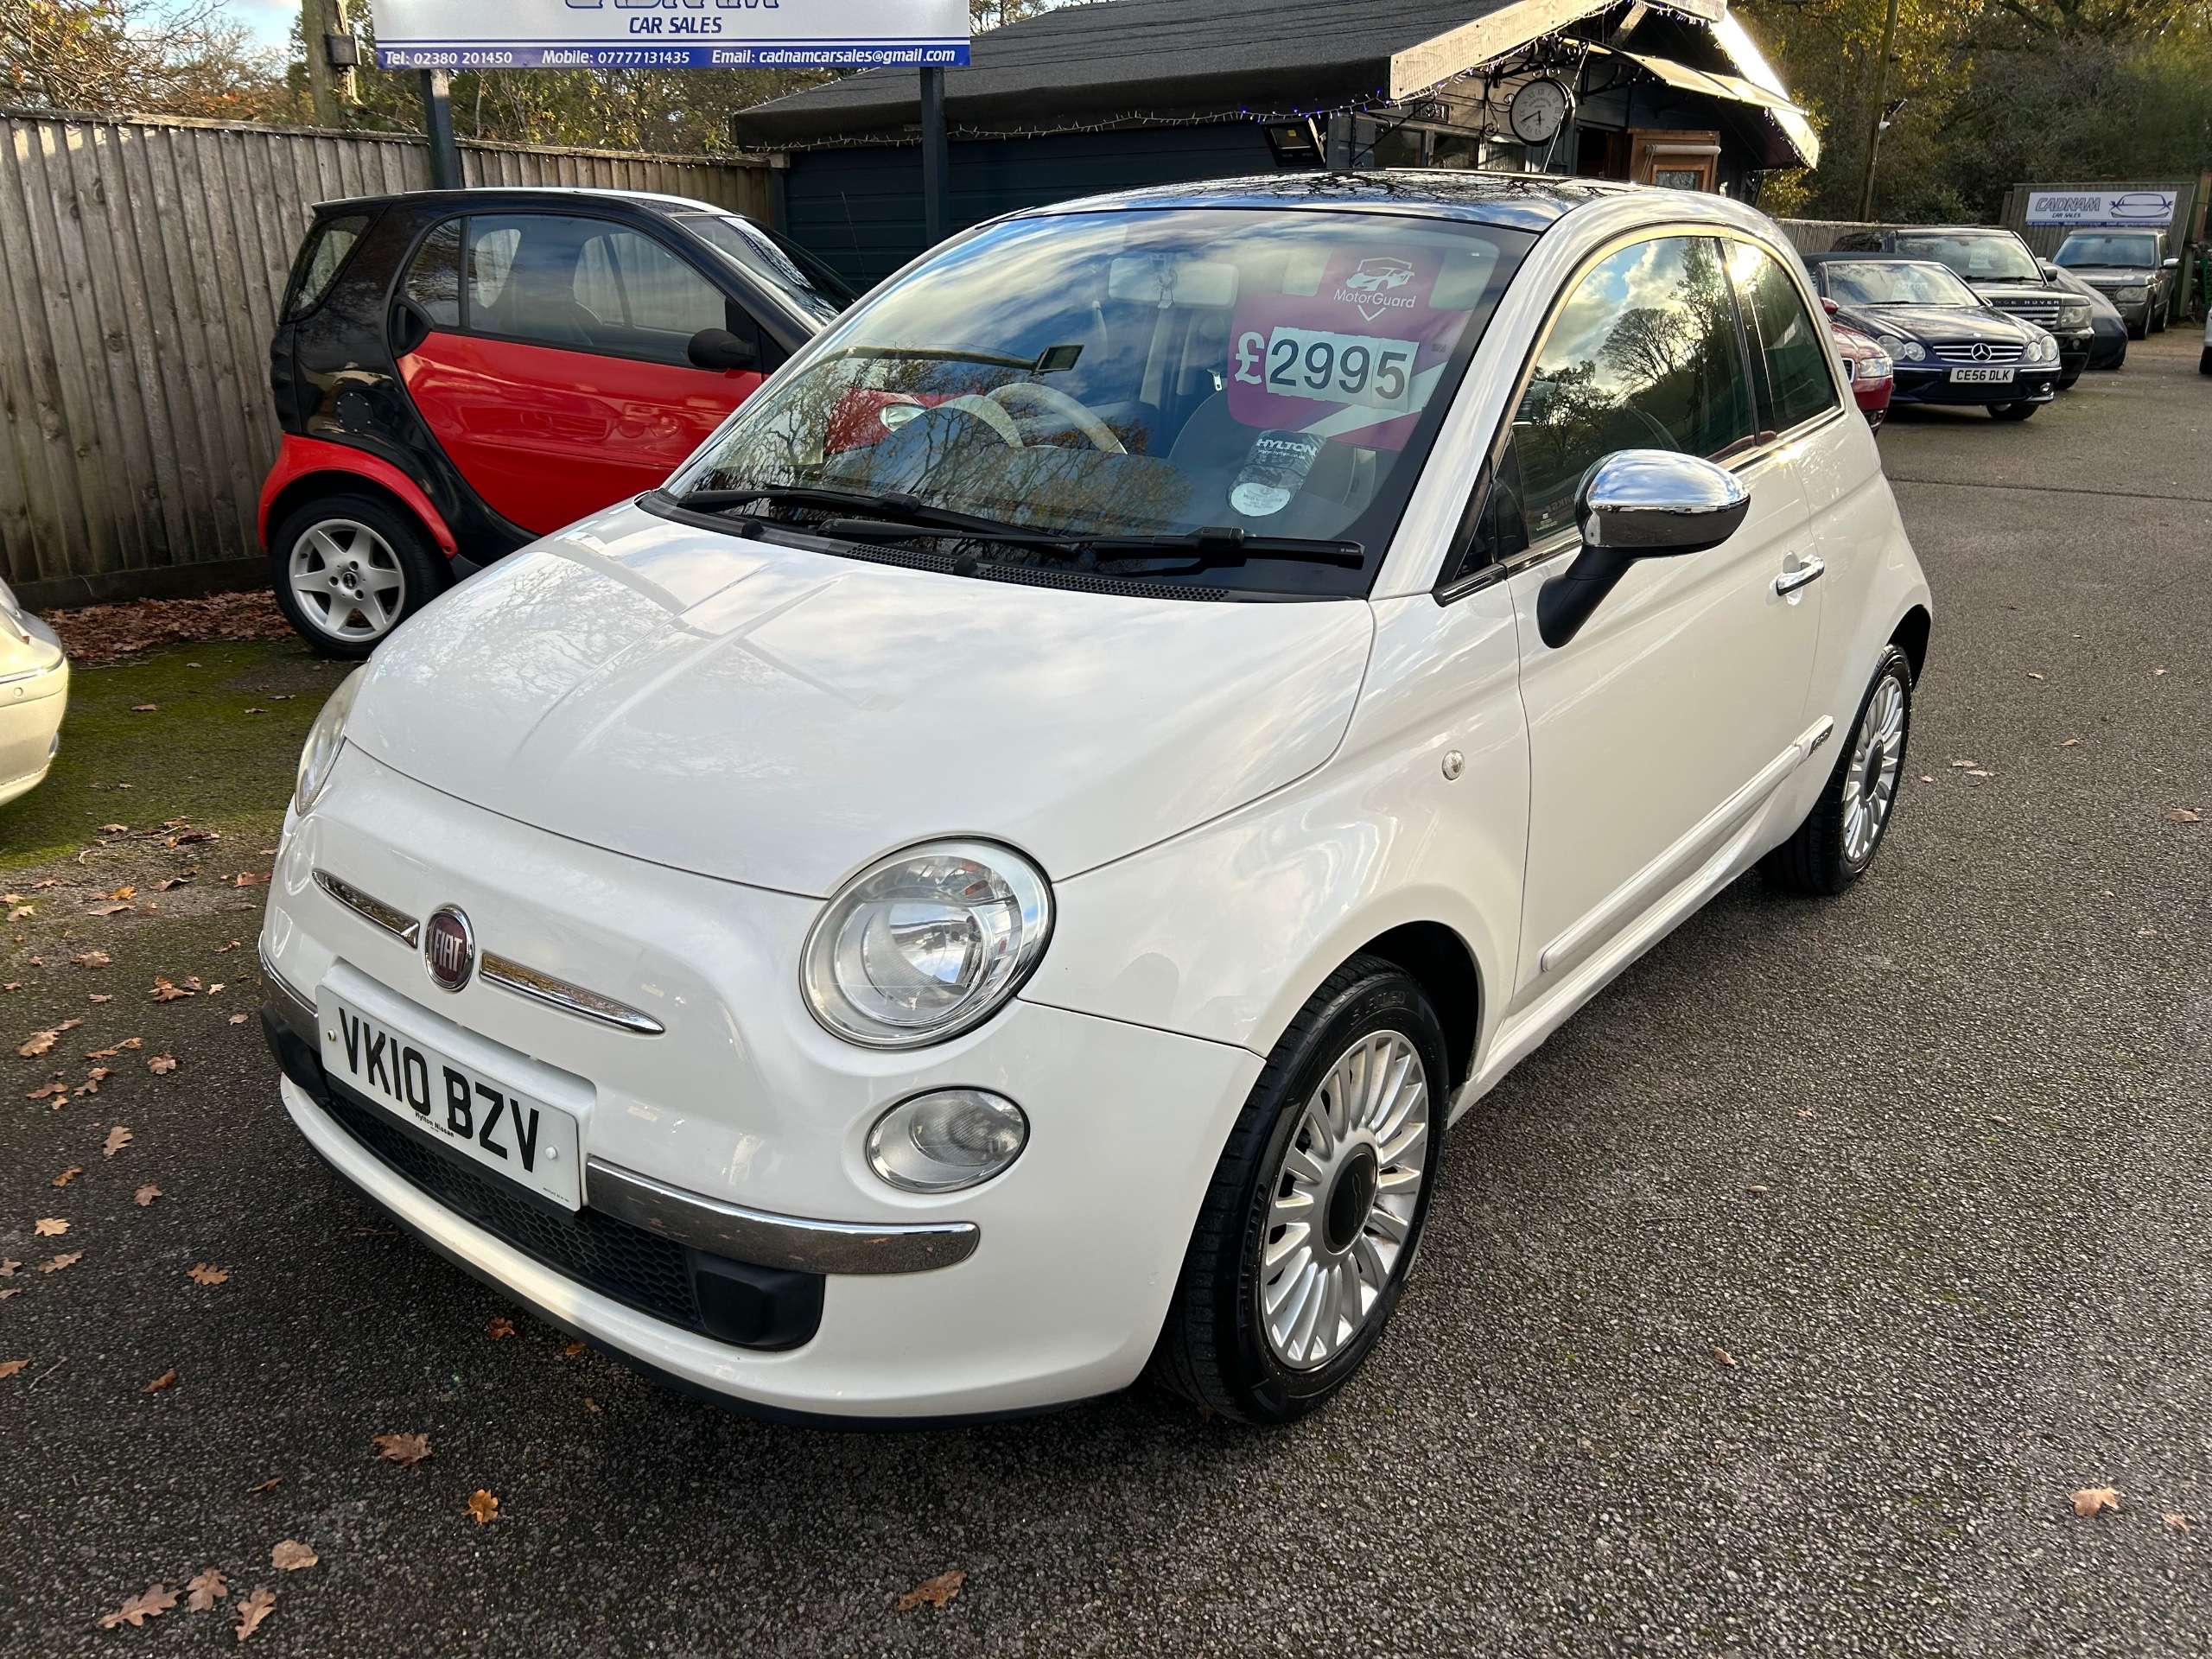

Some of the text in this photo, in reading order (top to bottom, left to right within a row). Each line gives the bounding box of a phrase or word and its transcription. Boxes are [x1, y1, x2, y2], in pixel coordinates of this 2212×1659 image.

[629, 16, 722, 35] CAR SALES
[385, 48, 955, 67] Tel: 02380 201450 Mobile: 07777131435 Email: cadnamcarsales@gmail.com
[2035, 197, 2101, 212] CADNAM
[1333, 289, 1416, 309] MotorGuard
[1235, 331, 1408, 400] £2995
[1956, 369, 2011, 381] CE56 DLK
[1256, 438, 1318, 456] HYLTON
[433, 928, 463, 972] FIAT
[338, 1007, 540, 1173] VK10 BZV
